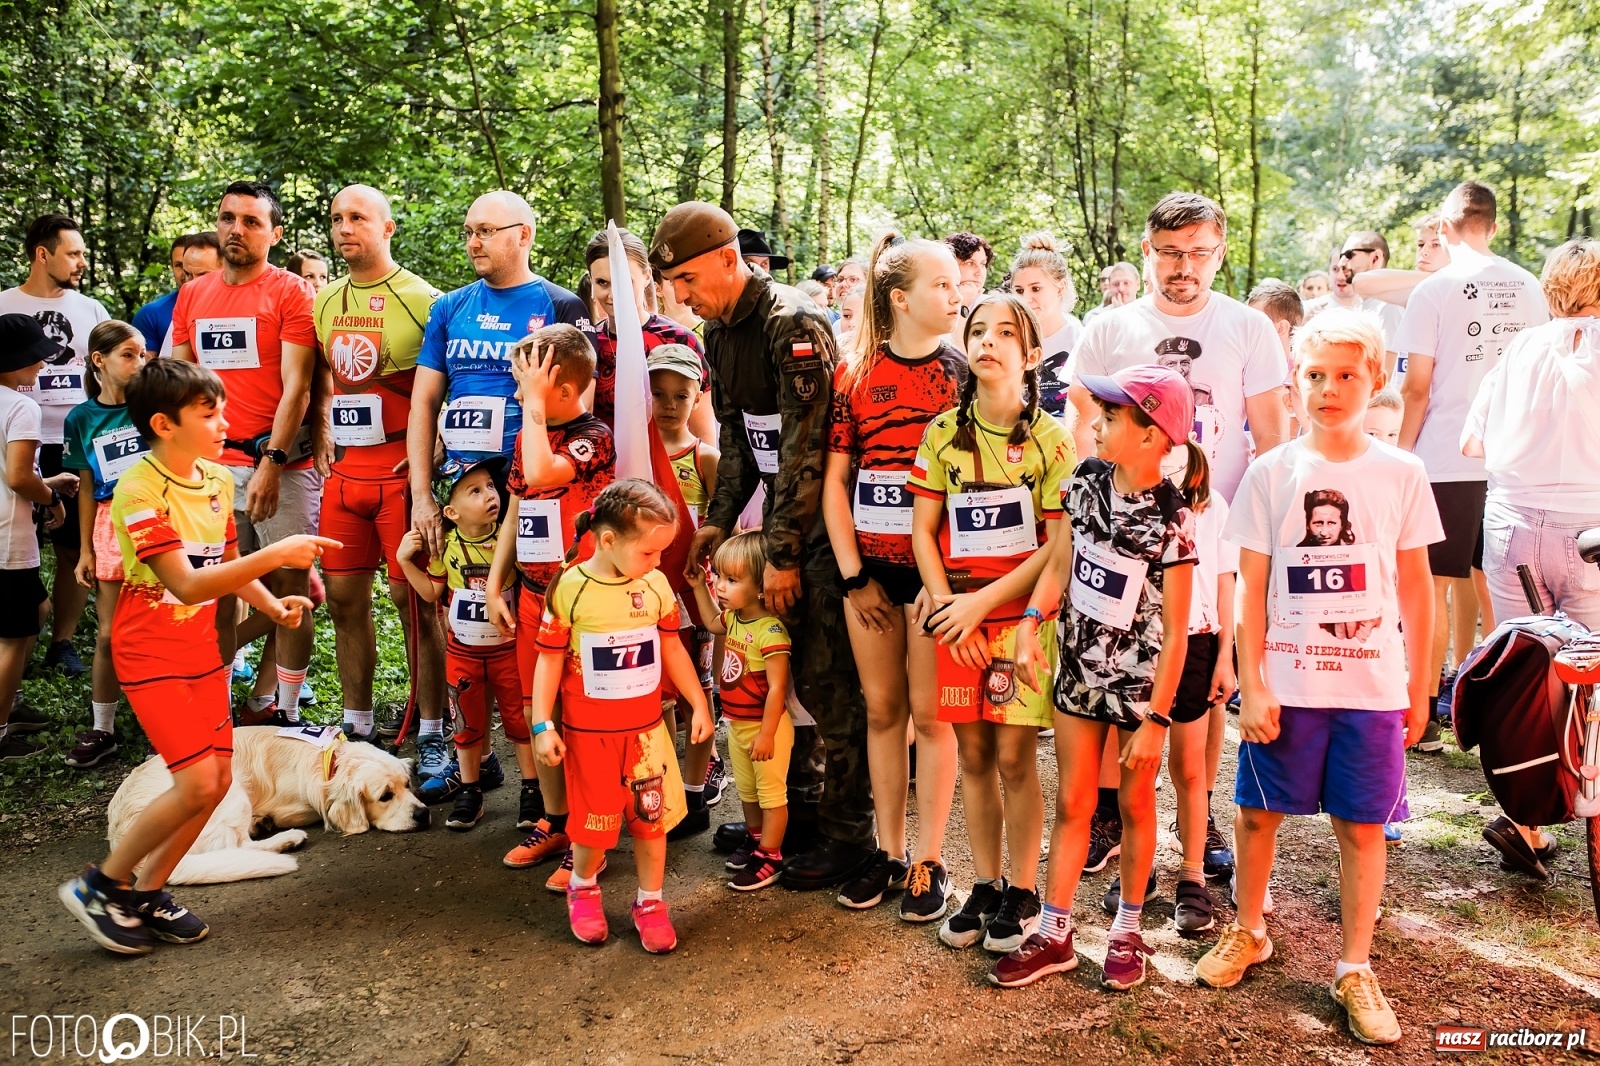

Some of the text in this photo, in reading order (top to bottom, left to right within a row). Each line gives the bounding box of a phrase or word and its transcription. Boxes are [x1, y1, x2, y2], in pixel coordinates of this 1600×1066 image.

[332, 315, 384, 328] RACIBORKI
[211, 333, 233, 348] 76
[446, 338, 514, 361] UNNE
[51, 375, 72, 388] 44
[872, 391, 896, 403] RACE
[340, 409, 359, 424] 80
[452, 411, 484, 427] 112
[116, 438, 140, 455] 75
[873, 486, 902, 505] 83
[971, 507, 1001, 529] 97
[1079, 560, 1107, 589] 96
[1307, 568, 1345, 590] 16
[629, 610, 648, 618] ALICJA
[1263, 640, 1300, 654] DANUTA
[1305, 645, 1381, 659] SIEDZIKÓWNA
[612, 645, 641, 668] 77
[1294, 659, 1343, 672] P. INKA
